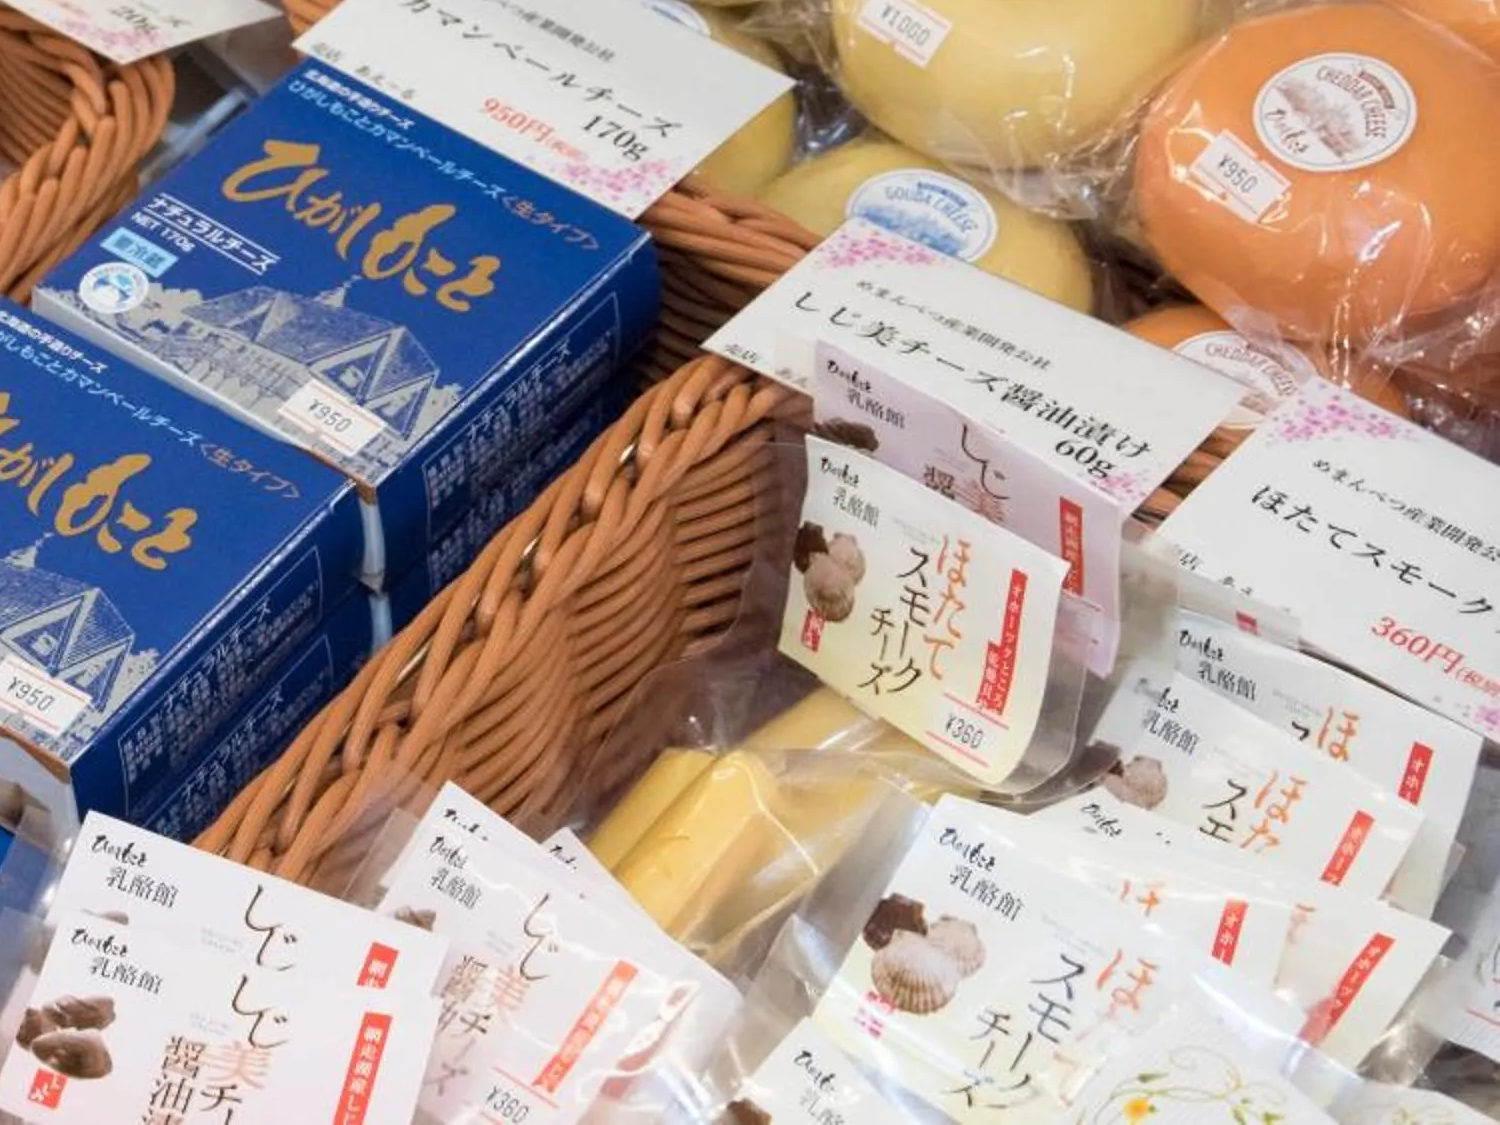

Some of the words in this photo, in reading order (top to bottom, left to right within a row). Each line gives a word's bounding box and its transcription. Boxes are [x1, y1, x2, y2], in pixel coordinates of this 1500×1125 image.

[880, 5, 930, 46] ¥1000
[580, 114, 649, 163] 170g
[1218, 154, 1258, 193] ¥950
[131, 212, 159, 234] NET
[147, 195, 280, 273] ナチュラルチーズ
[309, 398, 354, 435] ¥950
[1053, 436, 1115, 481] 60g
[887, 547, 931, 693] スモーク
[923, 535, 971, 680] ほたて
[858, 606, 895, 695] チーズ
[7, 679, 55, 712] ¥950
[945, 714, 984, 749] ¥360
[105, 866, 179, 909] 乳酪館
[89, 955, 164, 996] 乳酪館
[484, 1085, 530, 1123] ¥360
